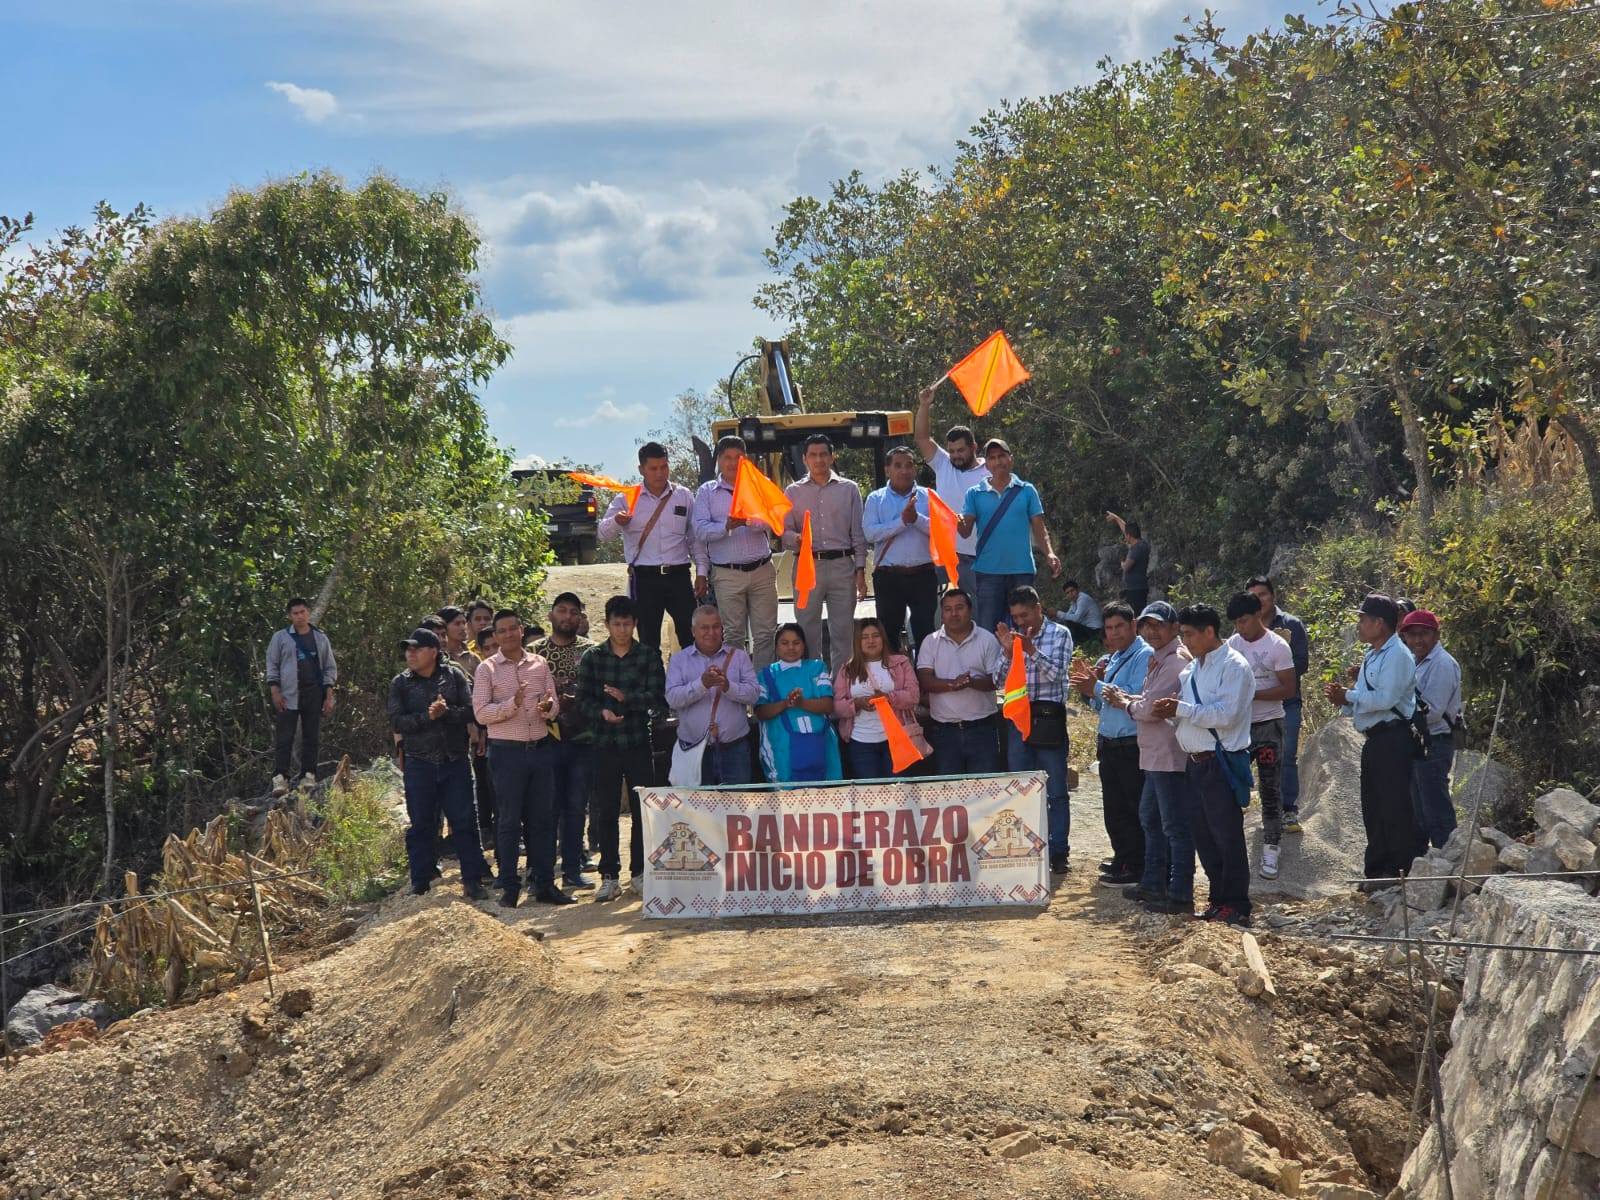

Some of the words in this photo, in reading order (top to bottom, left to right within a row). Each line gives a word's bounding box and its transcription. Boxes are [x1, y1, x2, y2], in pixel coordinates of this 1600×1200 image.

[726, 805, 969, 852] BANDERAZO
[725, 851, 827, 892] INICIO
[835, 850, 874, 888] DE
[882, 843, 971, 886] OBRA
